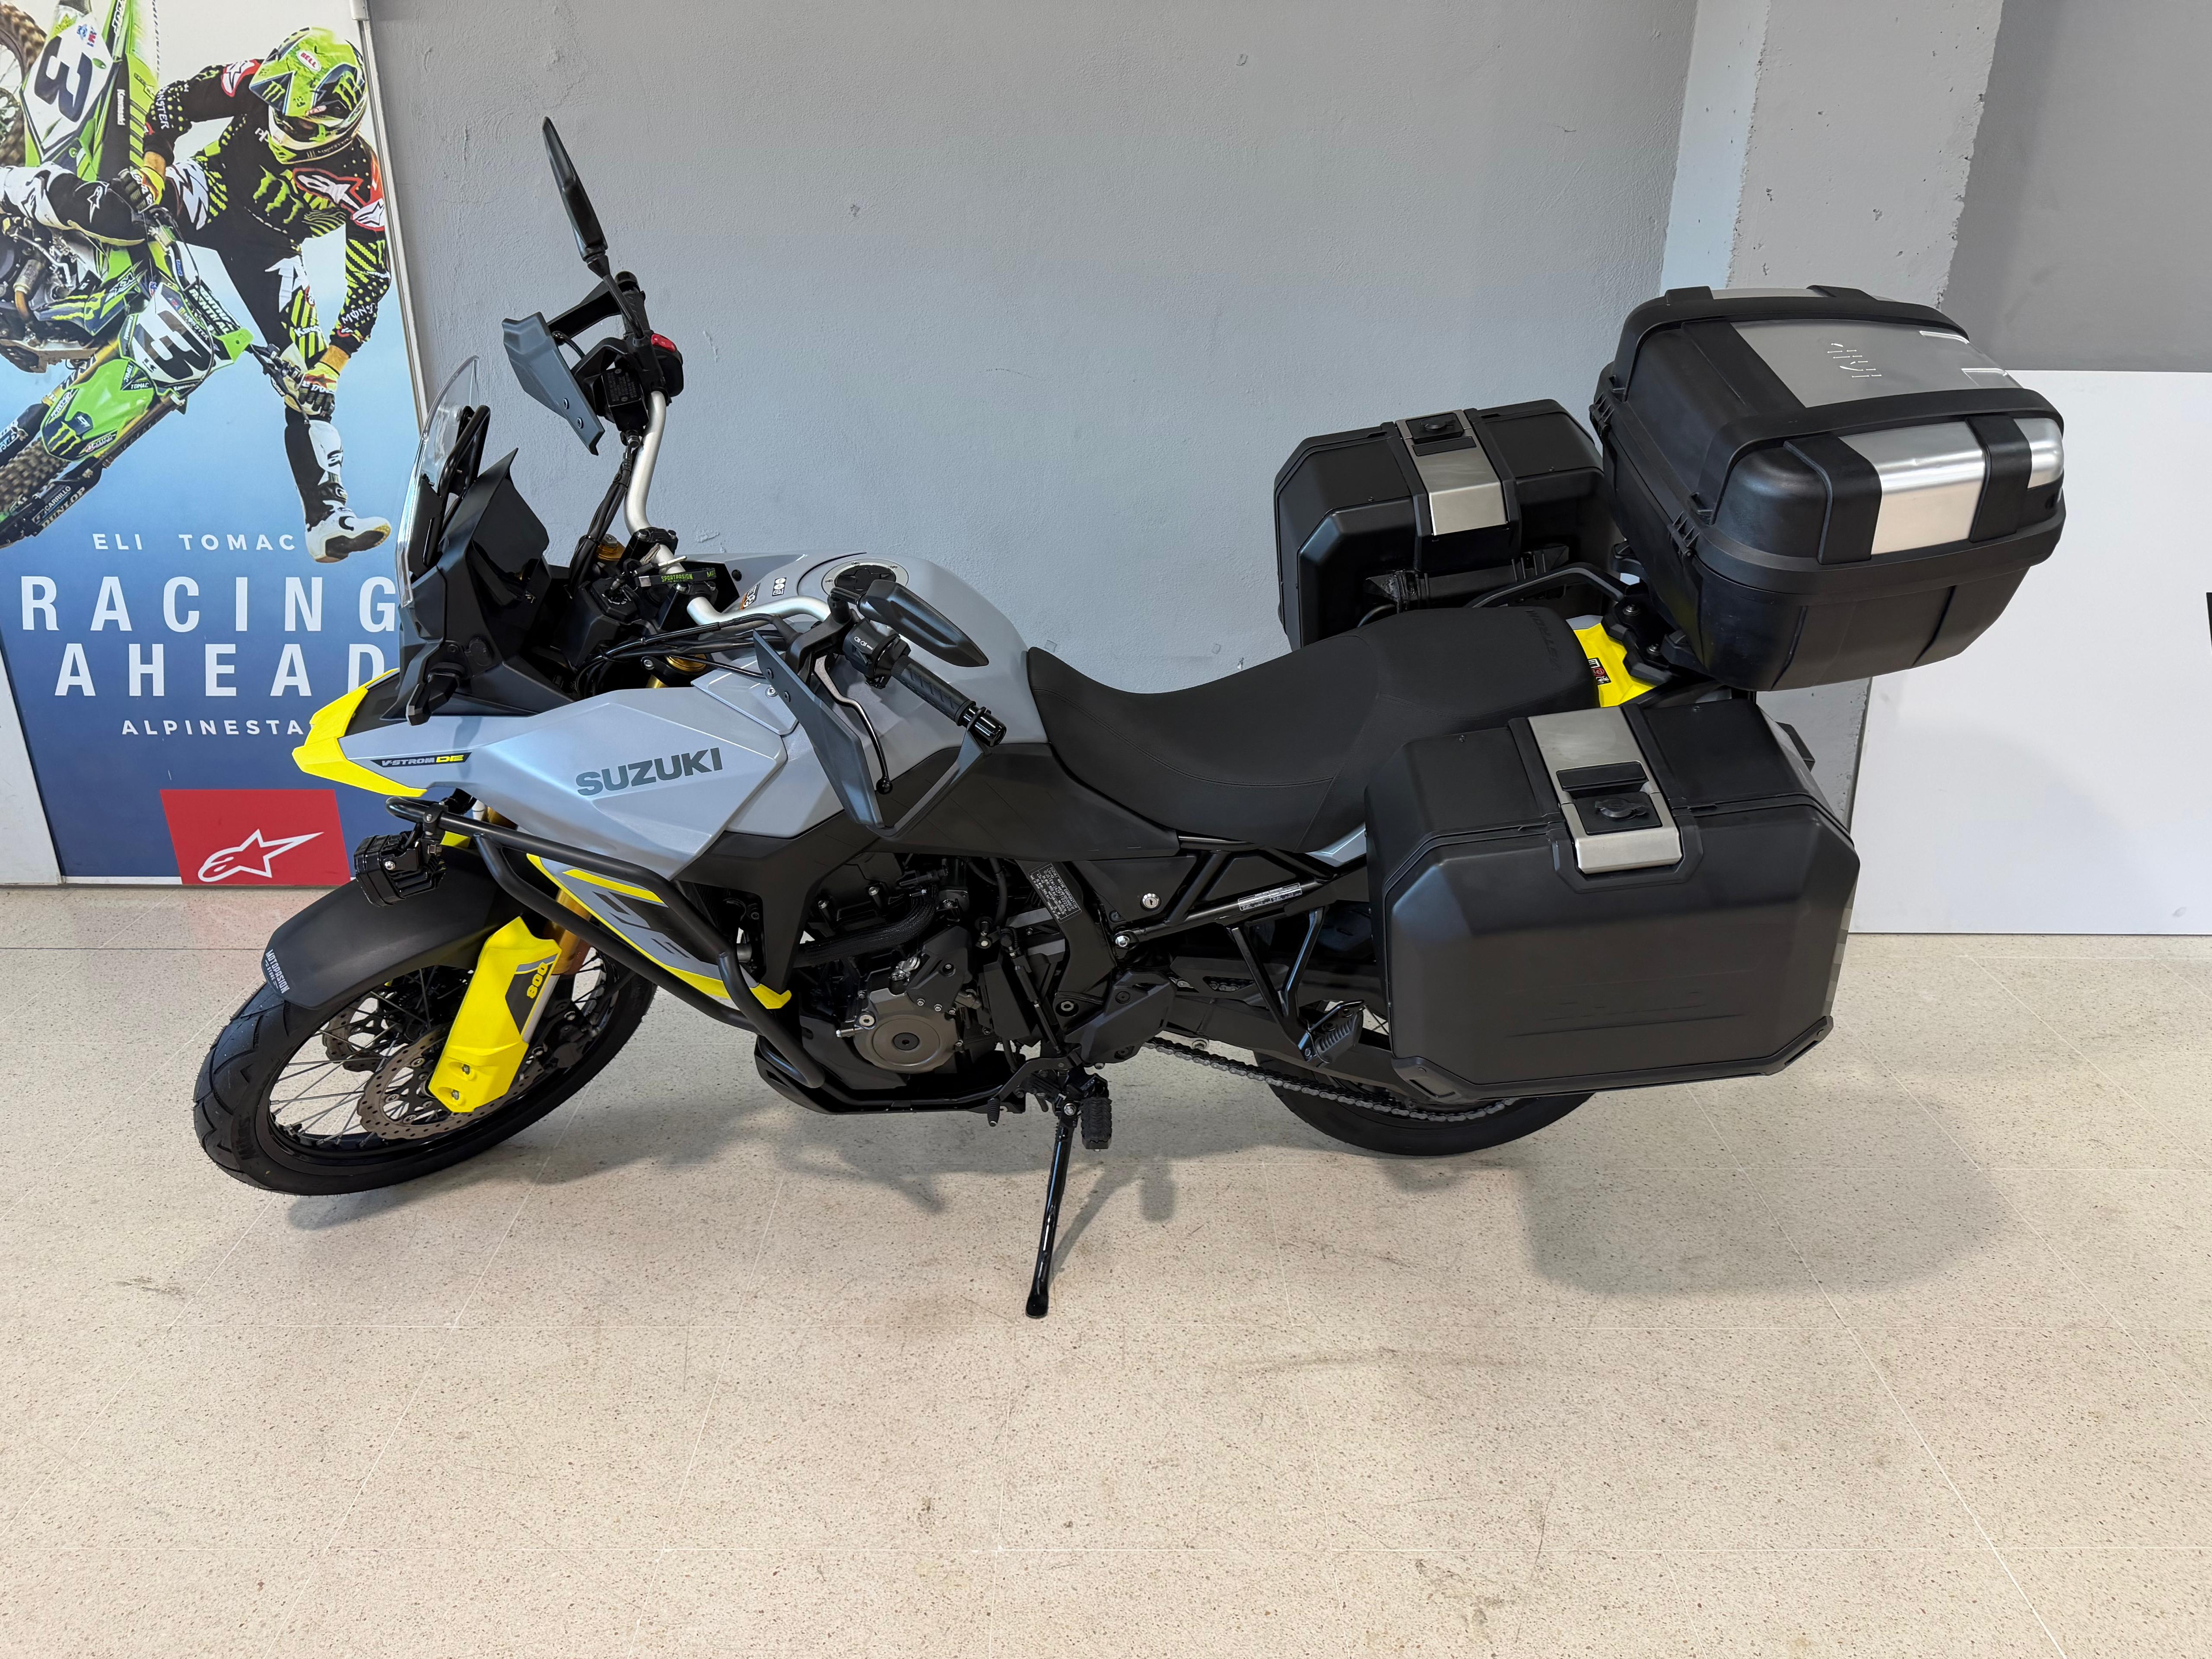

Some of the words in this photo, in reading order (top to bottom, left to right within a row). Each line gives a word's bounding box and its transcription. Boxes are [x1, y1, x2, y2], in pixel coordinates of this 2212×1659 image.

[34, 35, 92, 122] 3
[300, 52, 317, 68] BELL
[124, 364, 133, 382] TOMAC
[41, 486, 86, 528] DUNLOP
[45, 486, 71, 512] CARRILLO
[93, 534, 142, 551] ELI
[179, 534, 296, 551] TOMAC
[21, 575, 396, 632] RACING
[55, 643, 385, 696] AHEAD
[121, 720, 305, 735] ALPINESTA
[576, 747, 723, 796] SUZUKI
[265, 949, 290, 994] MOTOPASION
[527, 962, 548, 999] 800
